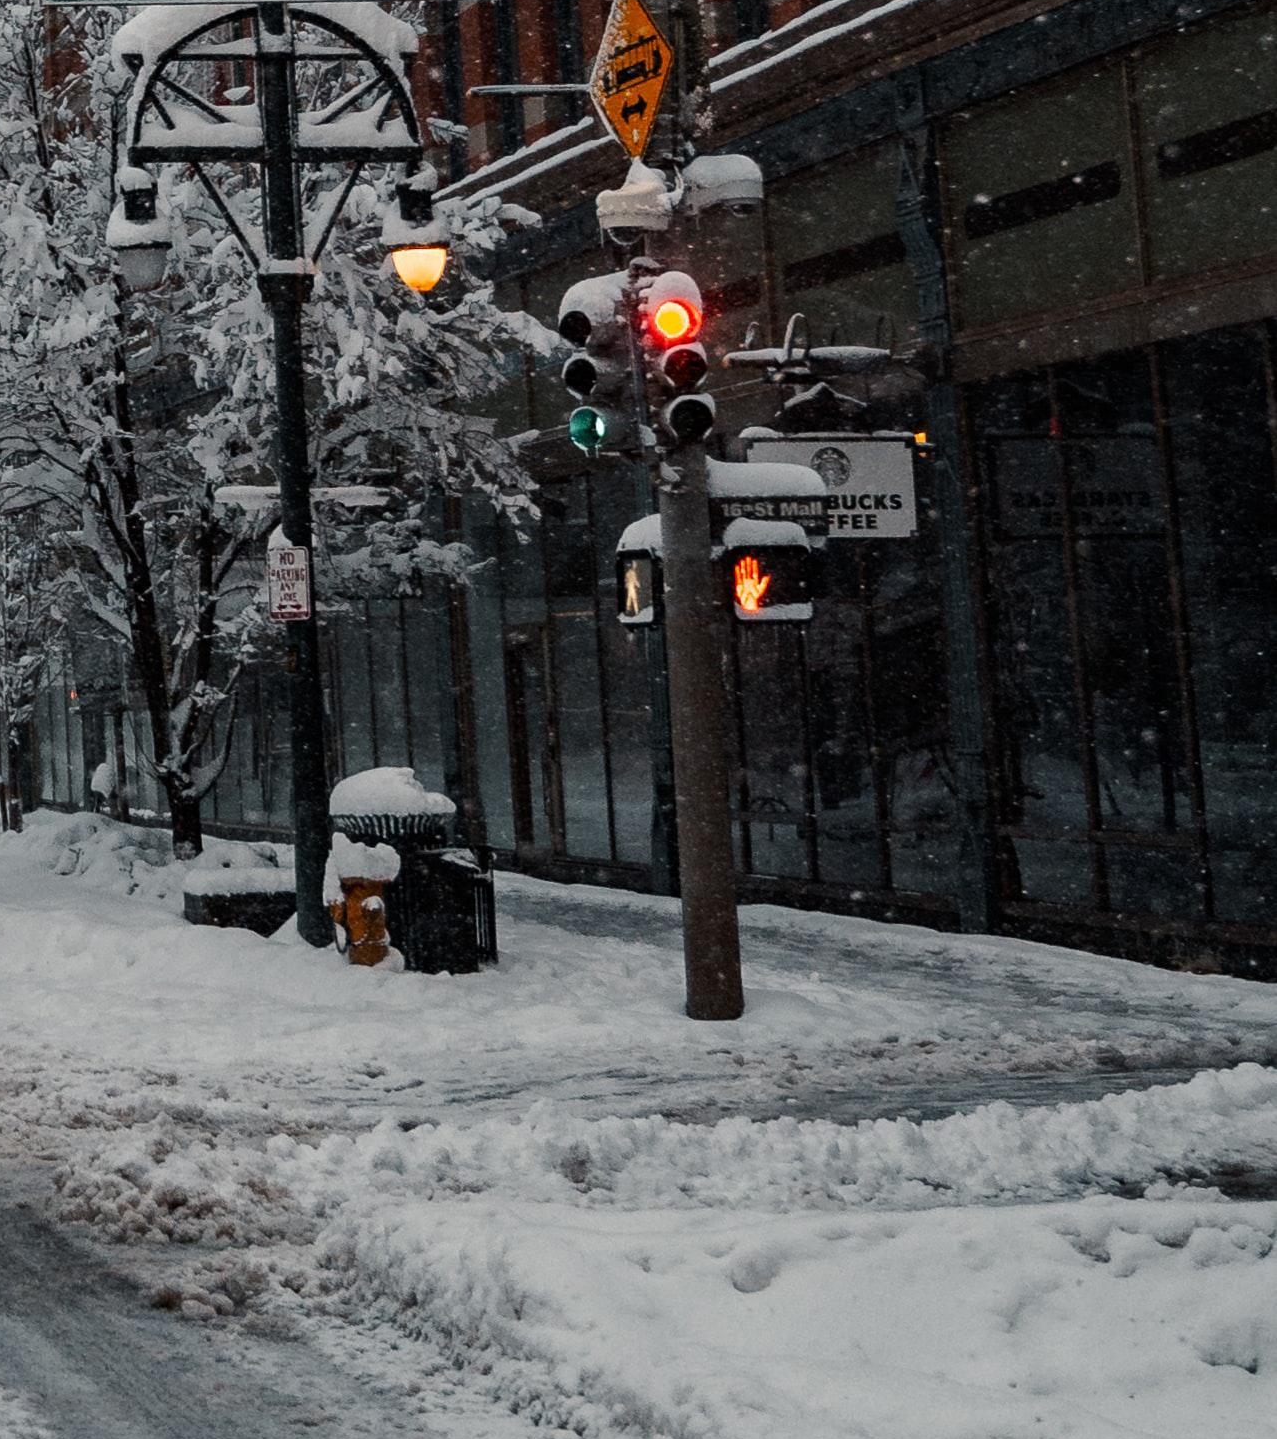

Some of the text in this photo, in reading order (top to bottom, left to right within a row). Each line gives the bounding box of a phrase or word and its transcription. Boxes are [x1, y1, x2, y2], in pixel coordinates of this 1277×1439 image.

[780, 501, 823, 517] Mall
[826, 494, 903, 510] BUCKS
[827, 513, 878, 530] FFEE
[279, 552, 295, 565] NO
